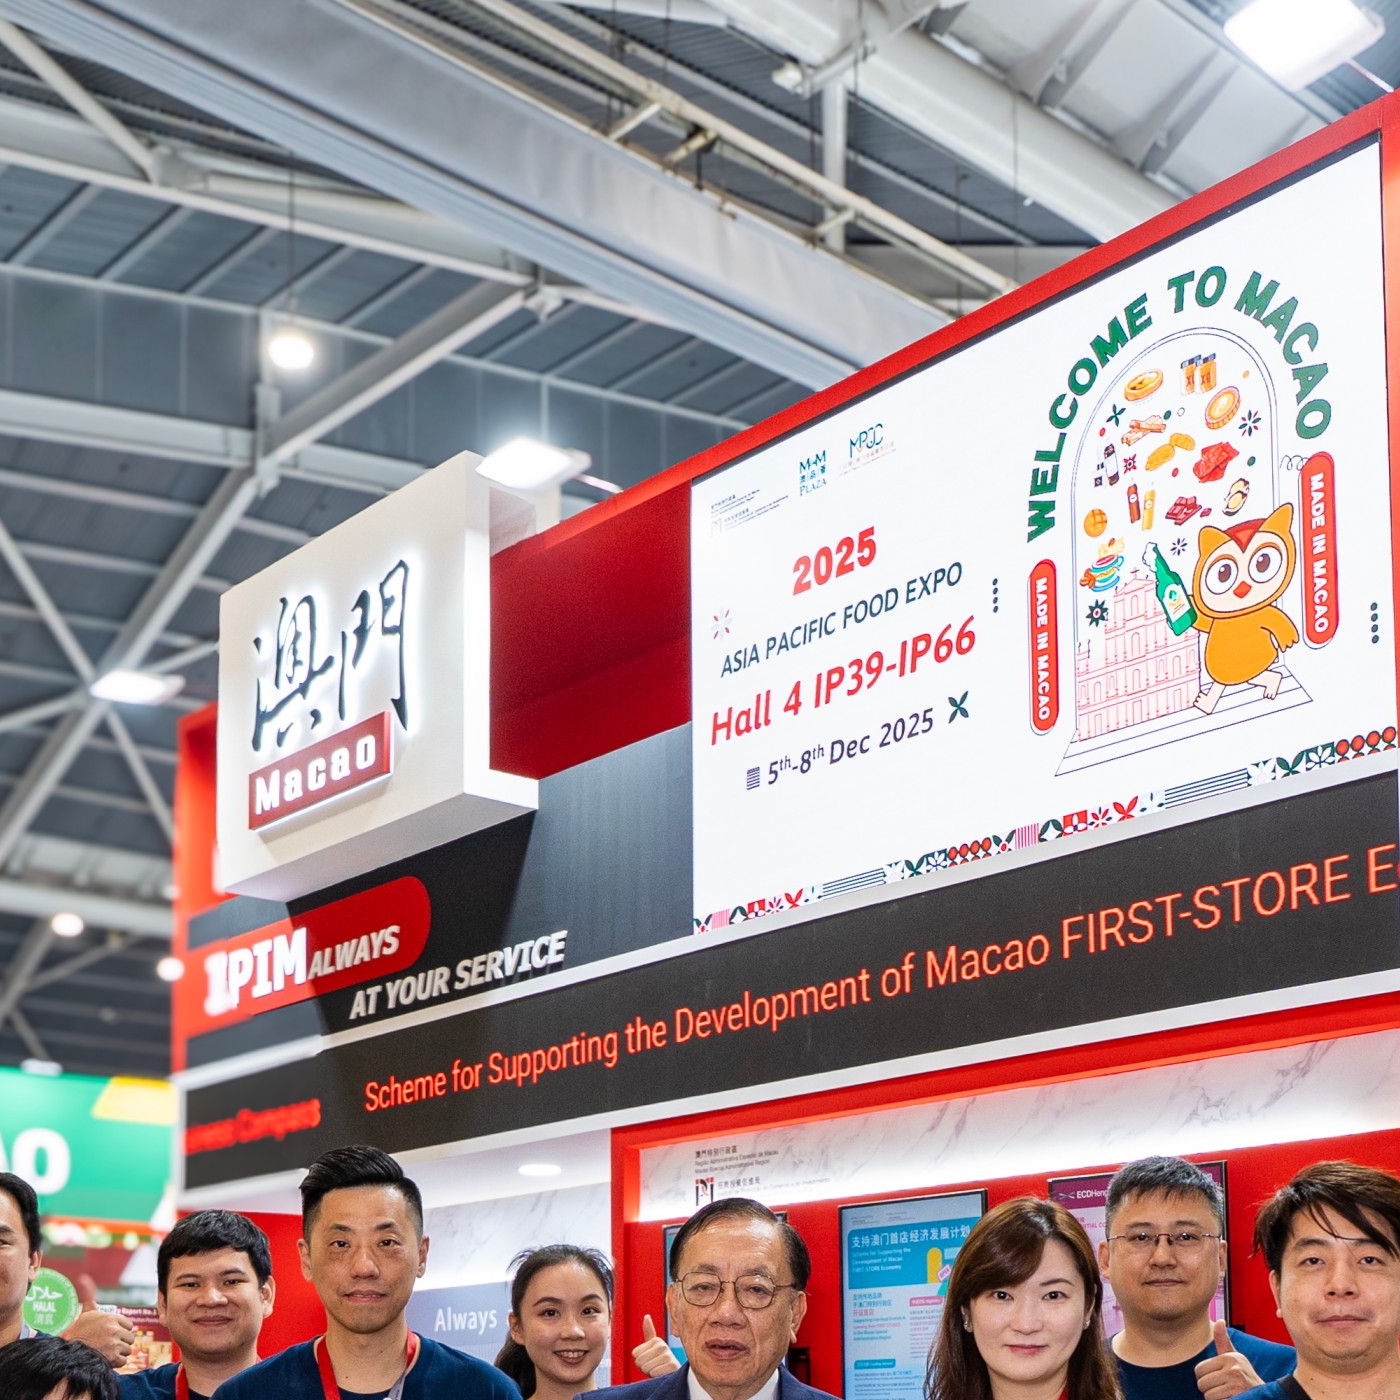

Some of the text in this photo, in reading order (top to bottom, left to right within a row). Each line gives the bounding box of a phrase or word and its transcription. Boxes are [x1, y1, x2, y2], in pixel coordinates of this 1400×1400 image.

[1027, 266, 1331, 542] WELCOME TO MACAO
[793, 526, 876, 596] 2025
[1310, 472, 1328, 633] MADE IN MACAO
[252, 560, 409, 751] 澳門
[721, 562, 962, 678] ASIA PACIFIC FOOD EXPO
[1034, 578, 1050, 721] MADE IN MACAO
[711, 615, 976, 746] Hall 4 IP39-IP66
[255, 734, 376, 815] Macao
[768, 707, 933, 785] 5th-8th Dec 2025
[205, 925, 400, 1016] IPIM ALWAYS
[349, 930, 568, 1020] AT YOUR SERVICE
[365, 1066, 446, 1111] Scheme
[451, 1056, 483, 1093] for
[487, 1030, 619, 1086] Supporting
[625, 1014, 667, 1055] the
[675, 966, 870, 1044] Development
[881, 952, 915, 998] of
[926, 935, 1050, 989] Macao
[1062, 854, 1351, 959] FIRST-STORE
[33, 1301, 57, 1313] HALAL
[434, 1306, 498, 1335] Always
